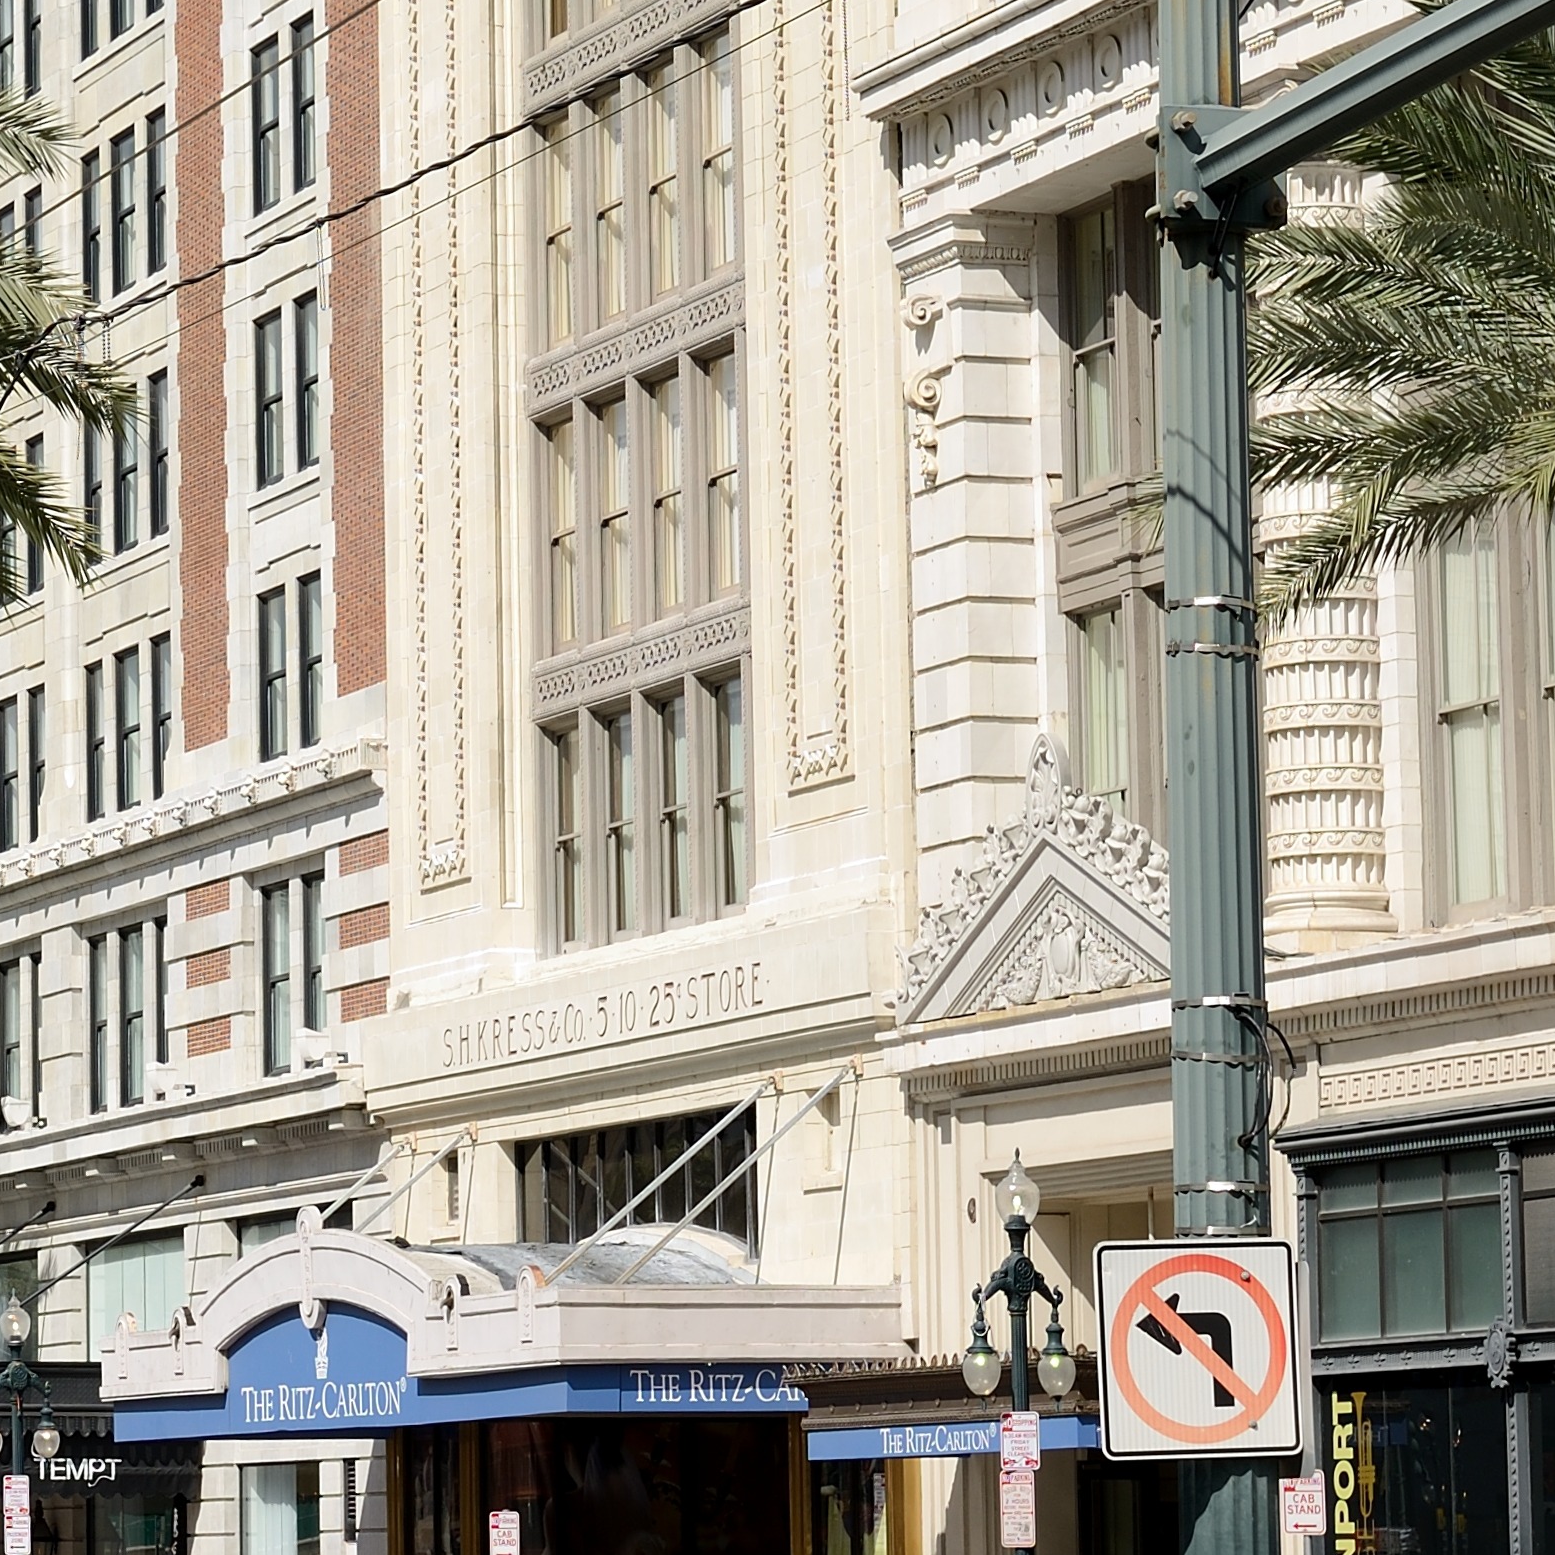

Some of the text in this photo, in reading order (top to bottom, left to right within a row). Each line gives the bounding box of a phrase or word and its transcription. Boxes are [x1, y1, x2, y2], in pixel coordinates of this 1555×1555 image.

[630, 1369, 681, 1403] THE
[241, 1386, 275, 1423] THE
[880, 1428, 903, 1454] THE
[1293, 1493, 1315, 1503] CAB
[1287, 1504, 1321, 1514] STAND
[497, 1530, 512, 1538] CAB
[493, 1539, 516, 1547] STAND
